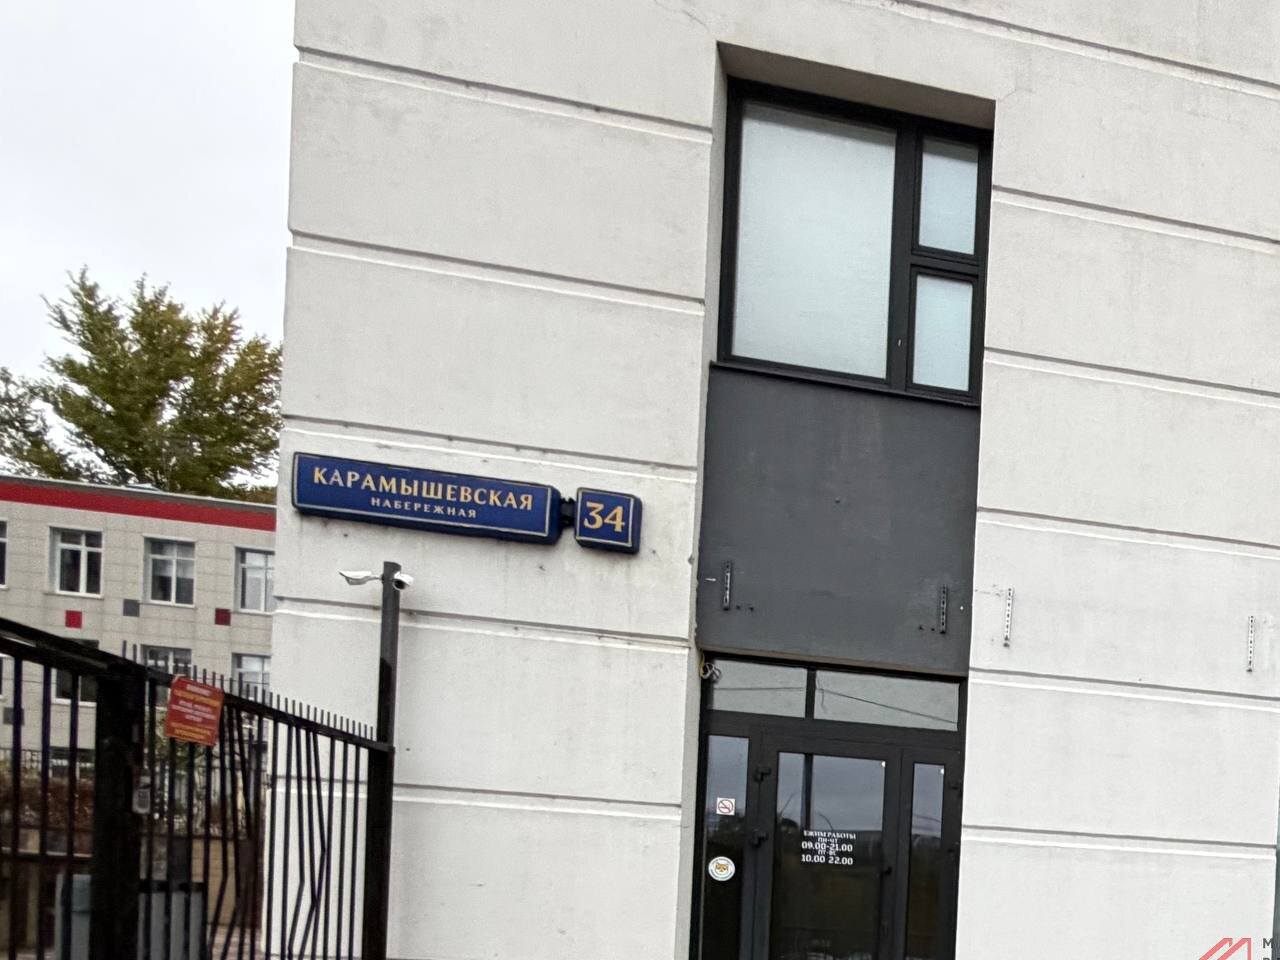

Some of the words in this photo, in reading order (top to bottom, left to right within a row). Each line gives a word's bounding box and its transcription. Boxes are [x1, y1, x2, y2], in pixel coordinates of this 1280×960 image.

[313, 466, 533, 511] КАРАМЫШЕВСКАЯ
[371, 496, 479, 519] НАБЕРЕЖНАЯ
[583, 501, 626, 533] 34
